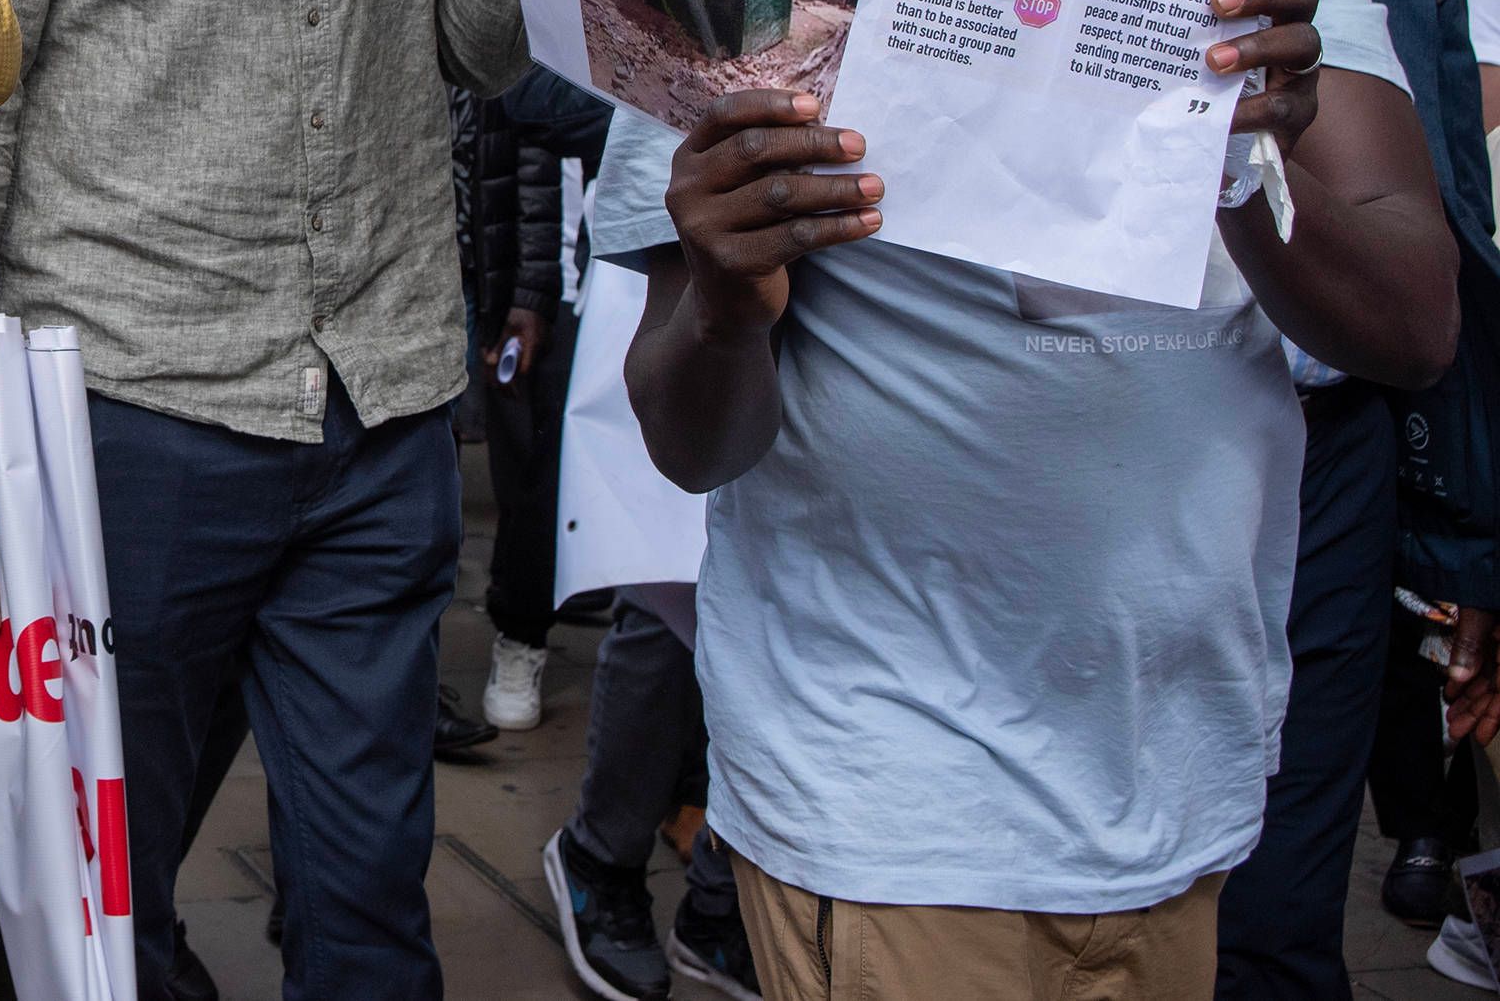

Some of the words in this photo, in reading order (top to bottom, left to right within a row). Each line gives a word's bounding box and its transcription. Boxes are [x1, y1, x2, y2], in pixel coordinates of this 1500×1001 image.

[896, 2, 922, 18] than
[925, 8, 936, 21] to
[938, 11, 953, 25] be
[954, 18, 1017, 40] associated
[967, 0, 1003, 19] better
[1084, 6, 1118, 21] peace
[1120, 13, 1143, 27] and
[1145, 19, 1191, 39] mutual
[1168, 3, 1218, 27] through
[888, 35, 915, 51] their
[916, 43, 971, 65] atrocities.
[893, 20, 917, 35] with
[919, 27, 947, 42] such
[949, 34, 956, 44] a
[958, 36, 992, 53] group
[1080, 24, 1123, 44] respect,
[1126, 34, 1148, 48] not
[1150, 38, 1199, 61] through
[1070, 59, 1083, 73] to
[1085, 61, 1102, 77] kill
[1103, 67, 1161, 91] strangers.
[1075, 42, 1119, 64] sending
[1121, 53, 1198, 80] mercenaries
[1025, 334, 1096, 354] NEVER
[1101, 334, 1150, 354] STOP
[1154, 327, 1244, 351] EXPLORING
